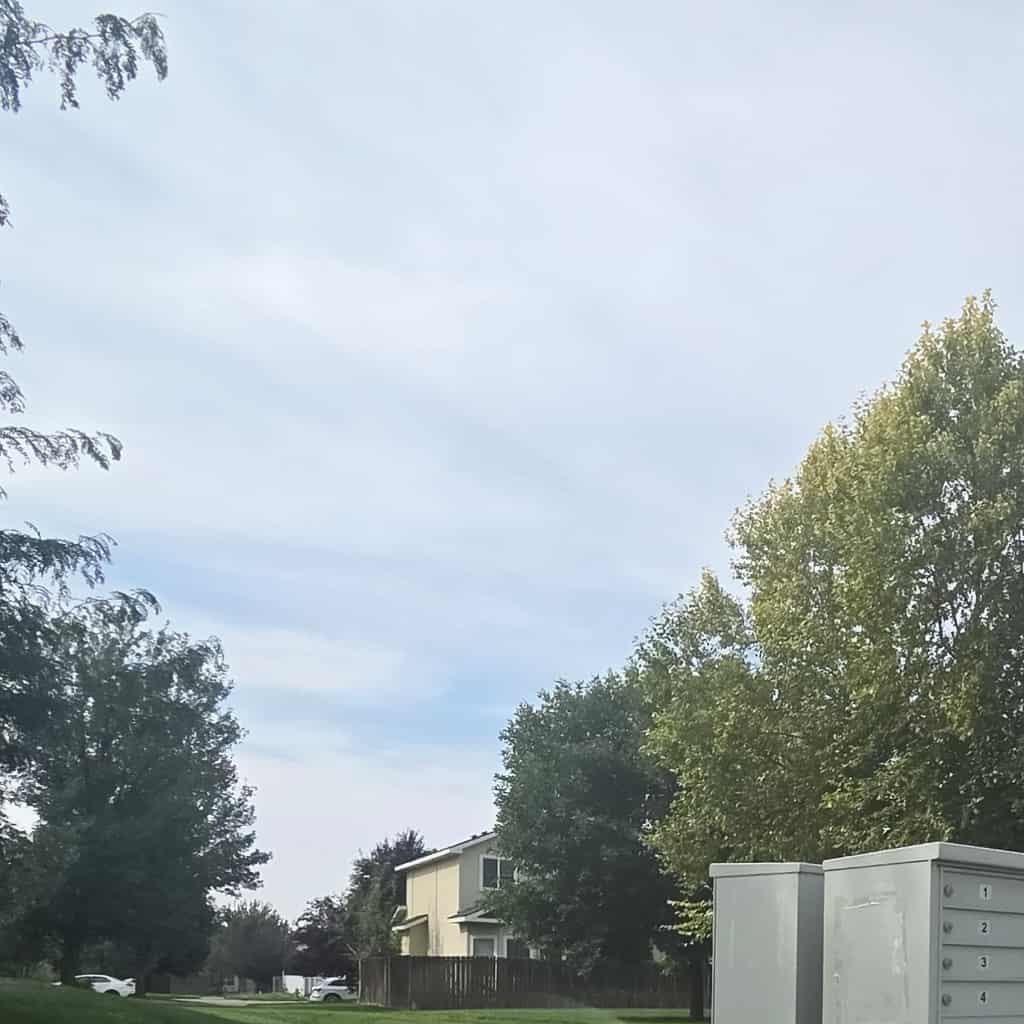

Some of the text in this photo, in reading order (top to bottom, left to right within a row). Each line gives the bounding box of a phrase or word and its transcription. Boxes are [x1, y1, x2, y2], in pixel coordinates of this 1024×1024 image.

[981, 922, 987, 933] 2
[980, 957, 987, 968] 3
[980, 991, 986, 1003] 4
